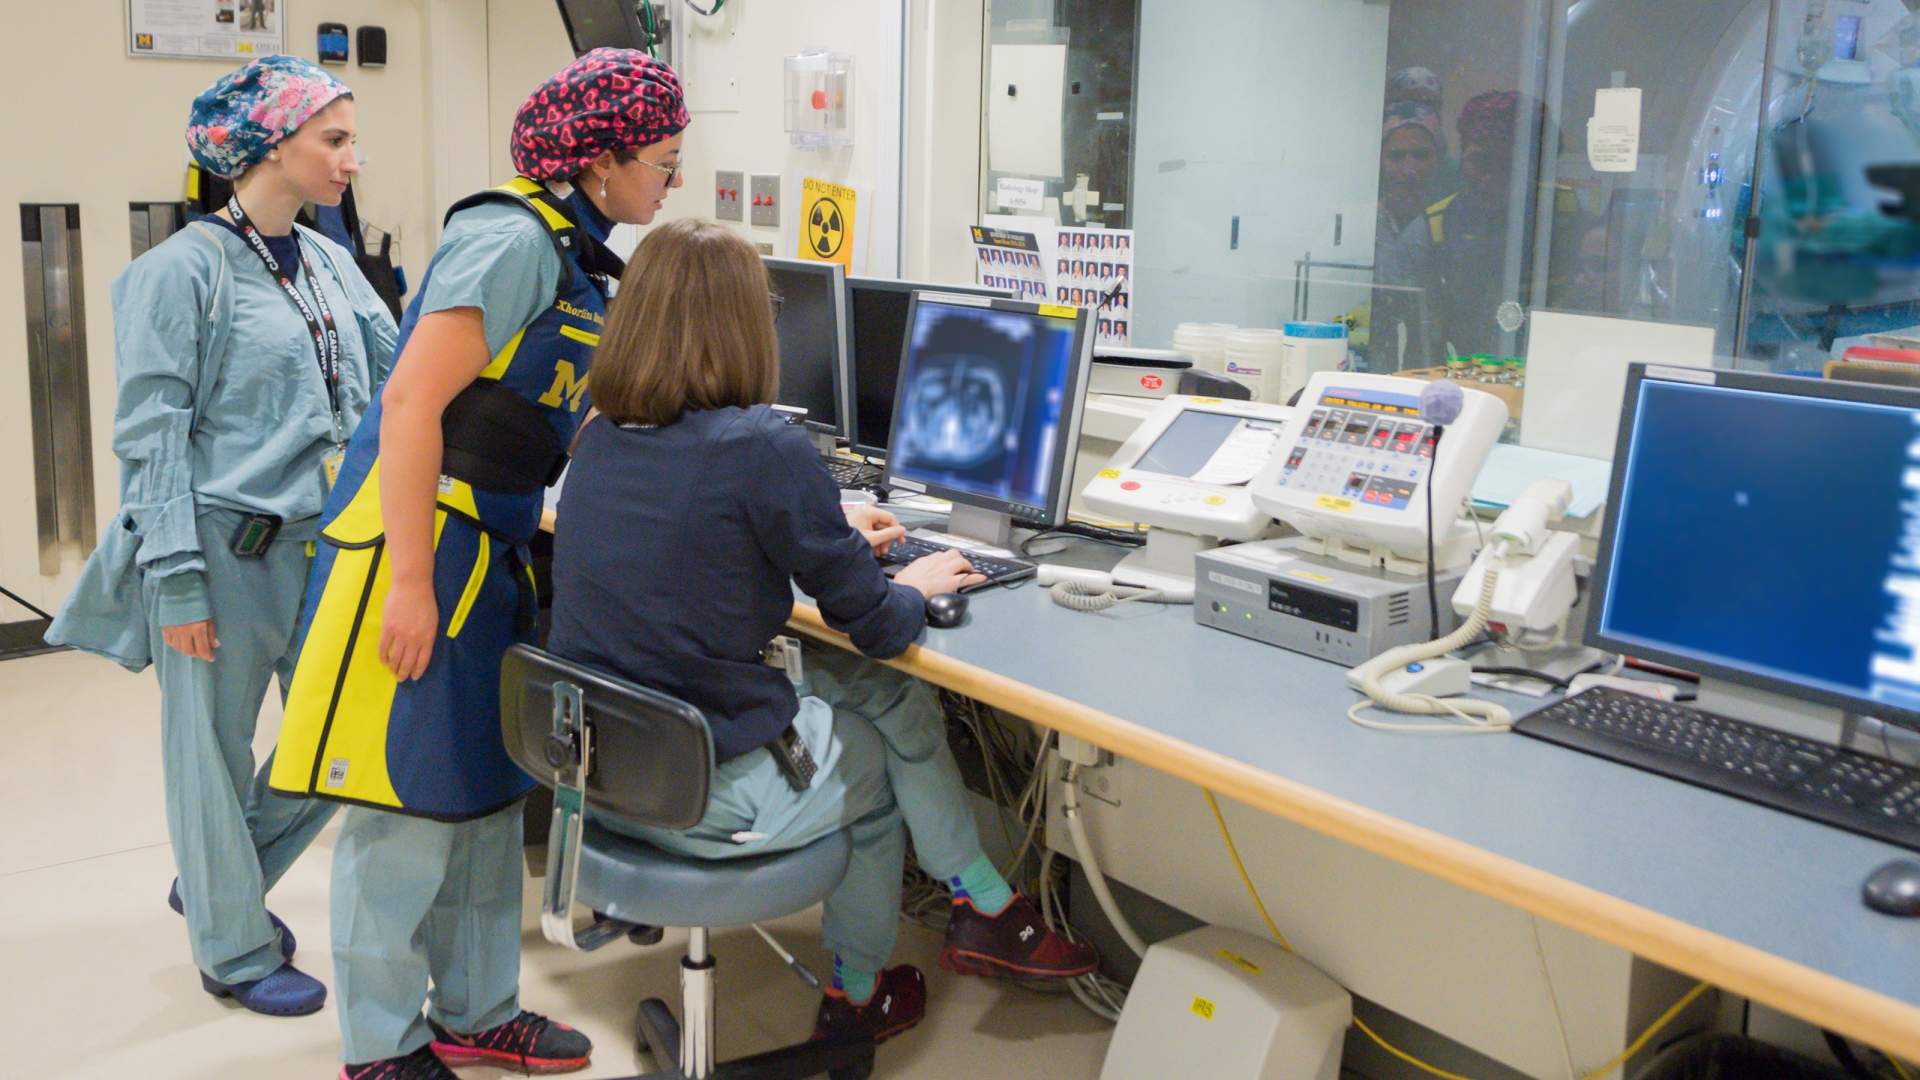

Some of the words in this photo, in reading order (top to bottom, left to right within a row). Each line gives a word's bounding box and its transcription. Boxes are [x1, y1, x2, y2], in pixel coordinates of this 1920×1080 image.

[803, 178, 814, 190] DO
[816, 182, 831, 195] NOT
[831, 186, 856, 201] ENTER
[248, 228, 279, 270] CANADA
[284, 280, 315, 322] CANADA
[309, 276, 330, 317] CANADA
[316, 334, 328, 380] CANADA
[327, 329, 339, 376] CANADA
[538, 359, 591, 412] M
